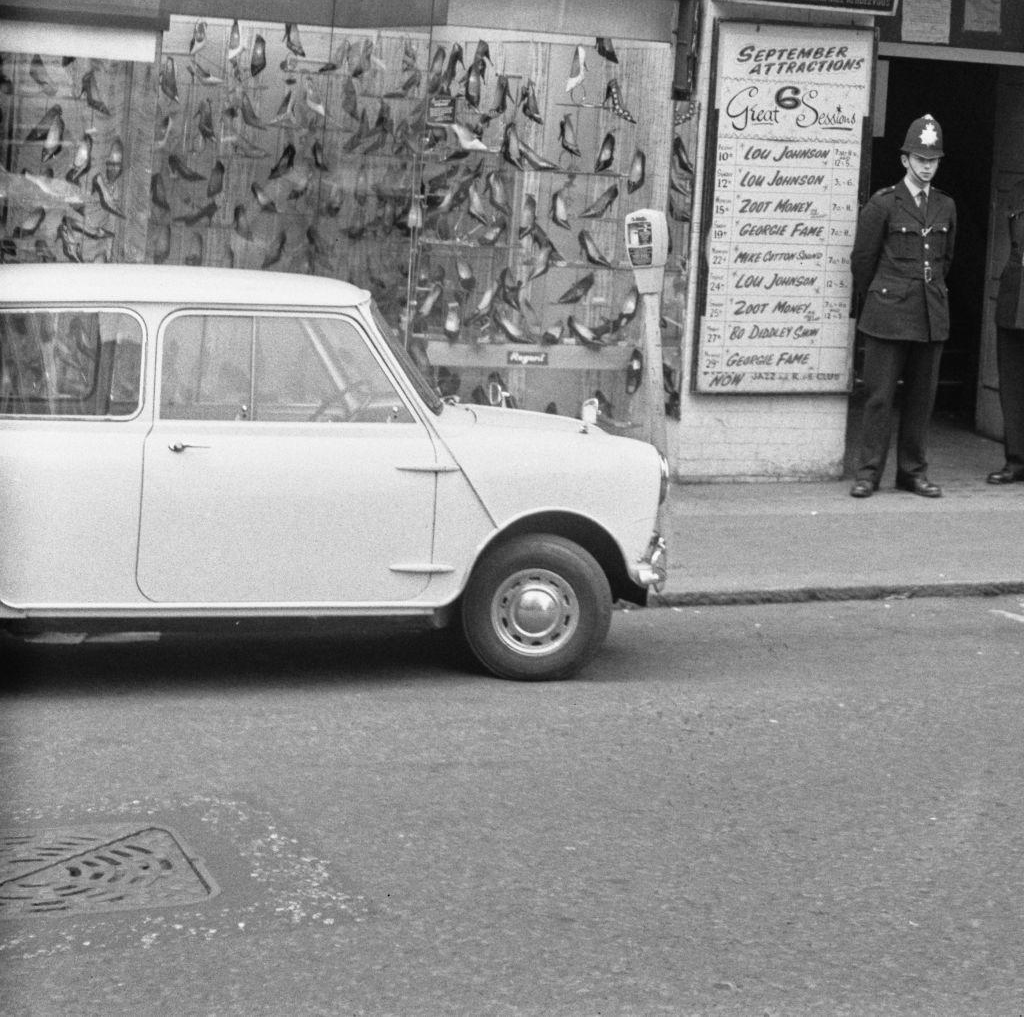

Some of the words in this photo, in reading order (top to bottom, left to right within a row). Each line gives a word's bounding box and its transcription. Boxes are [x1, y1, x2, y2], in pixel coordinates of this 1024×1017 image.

[737, 45, 849, 62] SEPTEMBER
[749, 58, 865, 75] ATTRACTIONS
[774, 85, 801, 110] 6
[726, 85, 780, 131] Great
[796, 89, 857, 128] Sessions
[744, 144, 773, 161] LOU
[773, 145, 831, 162] JOHNSON
[739, 170, 766, 188] LOU
[767, 170, 825, 187] JOHNSON
[738, 198, 773, 214] ZOOT
[774, 198, 813, 214] MONEY
[738, 222, 789, 238] GEORGIE
[790, 222, 825, 238] FAME
[734, 250, 763, 264] MIKE
[762, 249, 796, 263] COTTON
[735, 273, 765, 289] LOU
[764, 272, 818, 290] JOHNSON
[733, 300, 770, 316] ZOOT
[771, 300, 812, 315] MONEY
[729, 325, 746, 341] BO
[748, 324, 793, 340] DIDDLEY
[726, 352, 775, 368] GEORGIE
[775, 352, 811, 367] FAME
[708, 372, 746, 388] NOW
